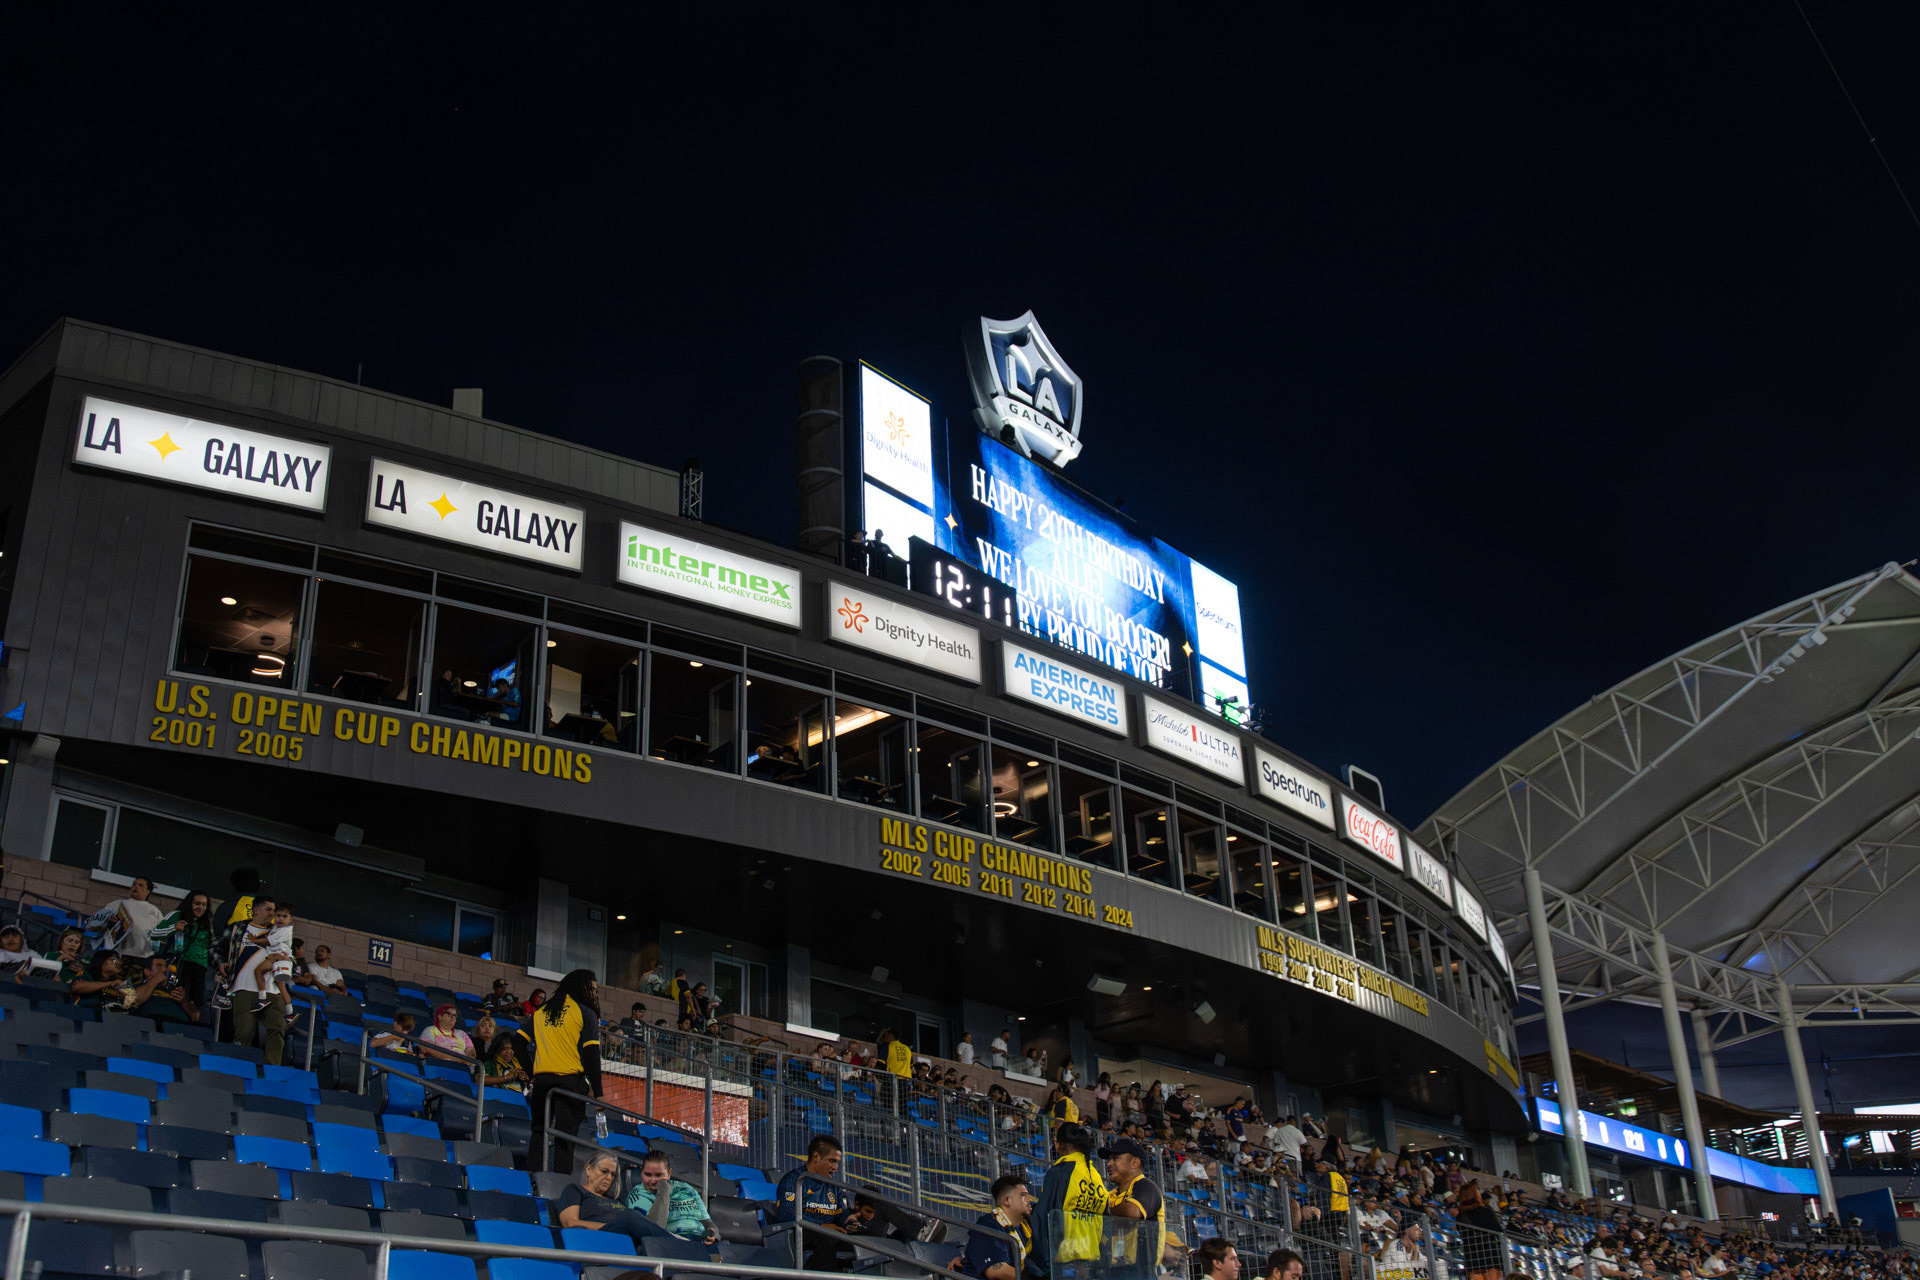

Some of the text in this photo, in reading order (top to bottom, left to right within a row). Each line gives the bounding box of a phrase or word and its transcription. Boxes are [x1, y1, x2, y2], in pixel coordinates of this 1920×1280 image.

[1005, 353, 1065, 425] LA
[1009, 403, 1075, 447] GALAXY
[84, 413, 321, 492] LA GALAXY
[866, 431, 929, 473] Dignity Health
[375, 475, 577, 554] LA GALAXY
[971, 464, 1164, 603] HAPPY 20TH BIRTHDAY
[627, 559, 792, 609] INTERNATIONAL MONEY EXPRESS
[628, 535, 791, 600] intermex
[936, 561, 1011, 627] 12:11
[977, 537, 1171, 671] WE LOVE YOU BOOGER!
[876, 616, 971, 659] Dignity Health
[1014, 653, 1115, 705] AMERICAN
[1031, 678, 1118, 725] EXPRESS
[150, 716, 304, 762] 2001 2005
[155, 679, 592, 784] U.S. OPEN CUP CHAMPIONS
[1148, 710, 1239, 760] Michelob ULTRA
[1163, 735, 1229, 768] SUPERIOR LIGHT BEER
[1262, 761, 1324, 809] Spectrum
[881, 817, 1093, 894] MLS CUP CHAMPIONS
[1349, 804, 1395, 860] Coca-Cola
[881, 848, 1134, 928] 2002 2005 2011 2012 2014 2024
[1415, 851, 1446, 898] Modelo
[371, 945, 390, 962] 141
[1257, 926, 1286, 955] MLS
[1359, 965, 1391, 998] SHIELD
[1390, 980, 1429, 1017] WINNERS
[1261, 952, 1285, 974] 1998
[1288, 960, 1310, 984] 2002
[1075, 1194, 1104, 1212] EVENT
[1078, 1179, 1105, 1199] CSC
[1071, 1208, 1096, 1223] STAFF
